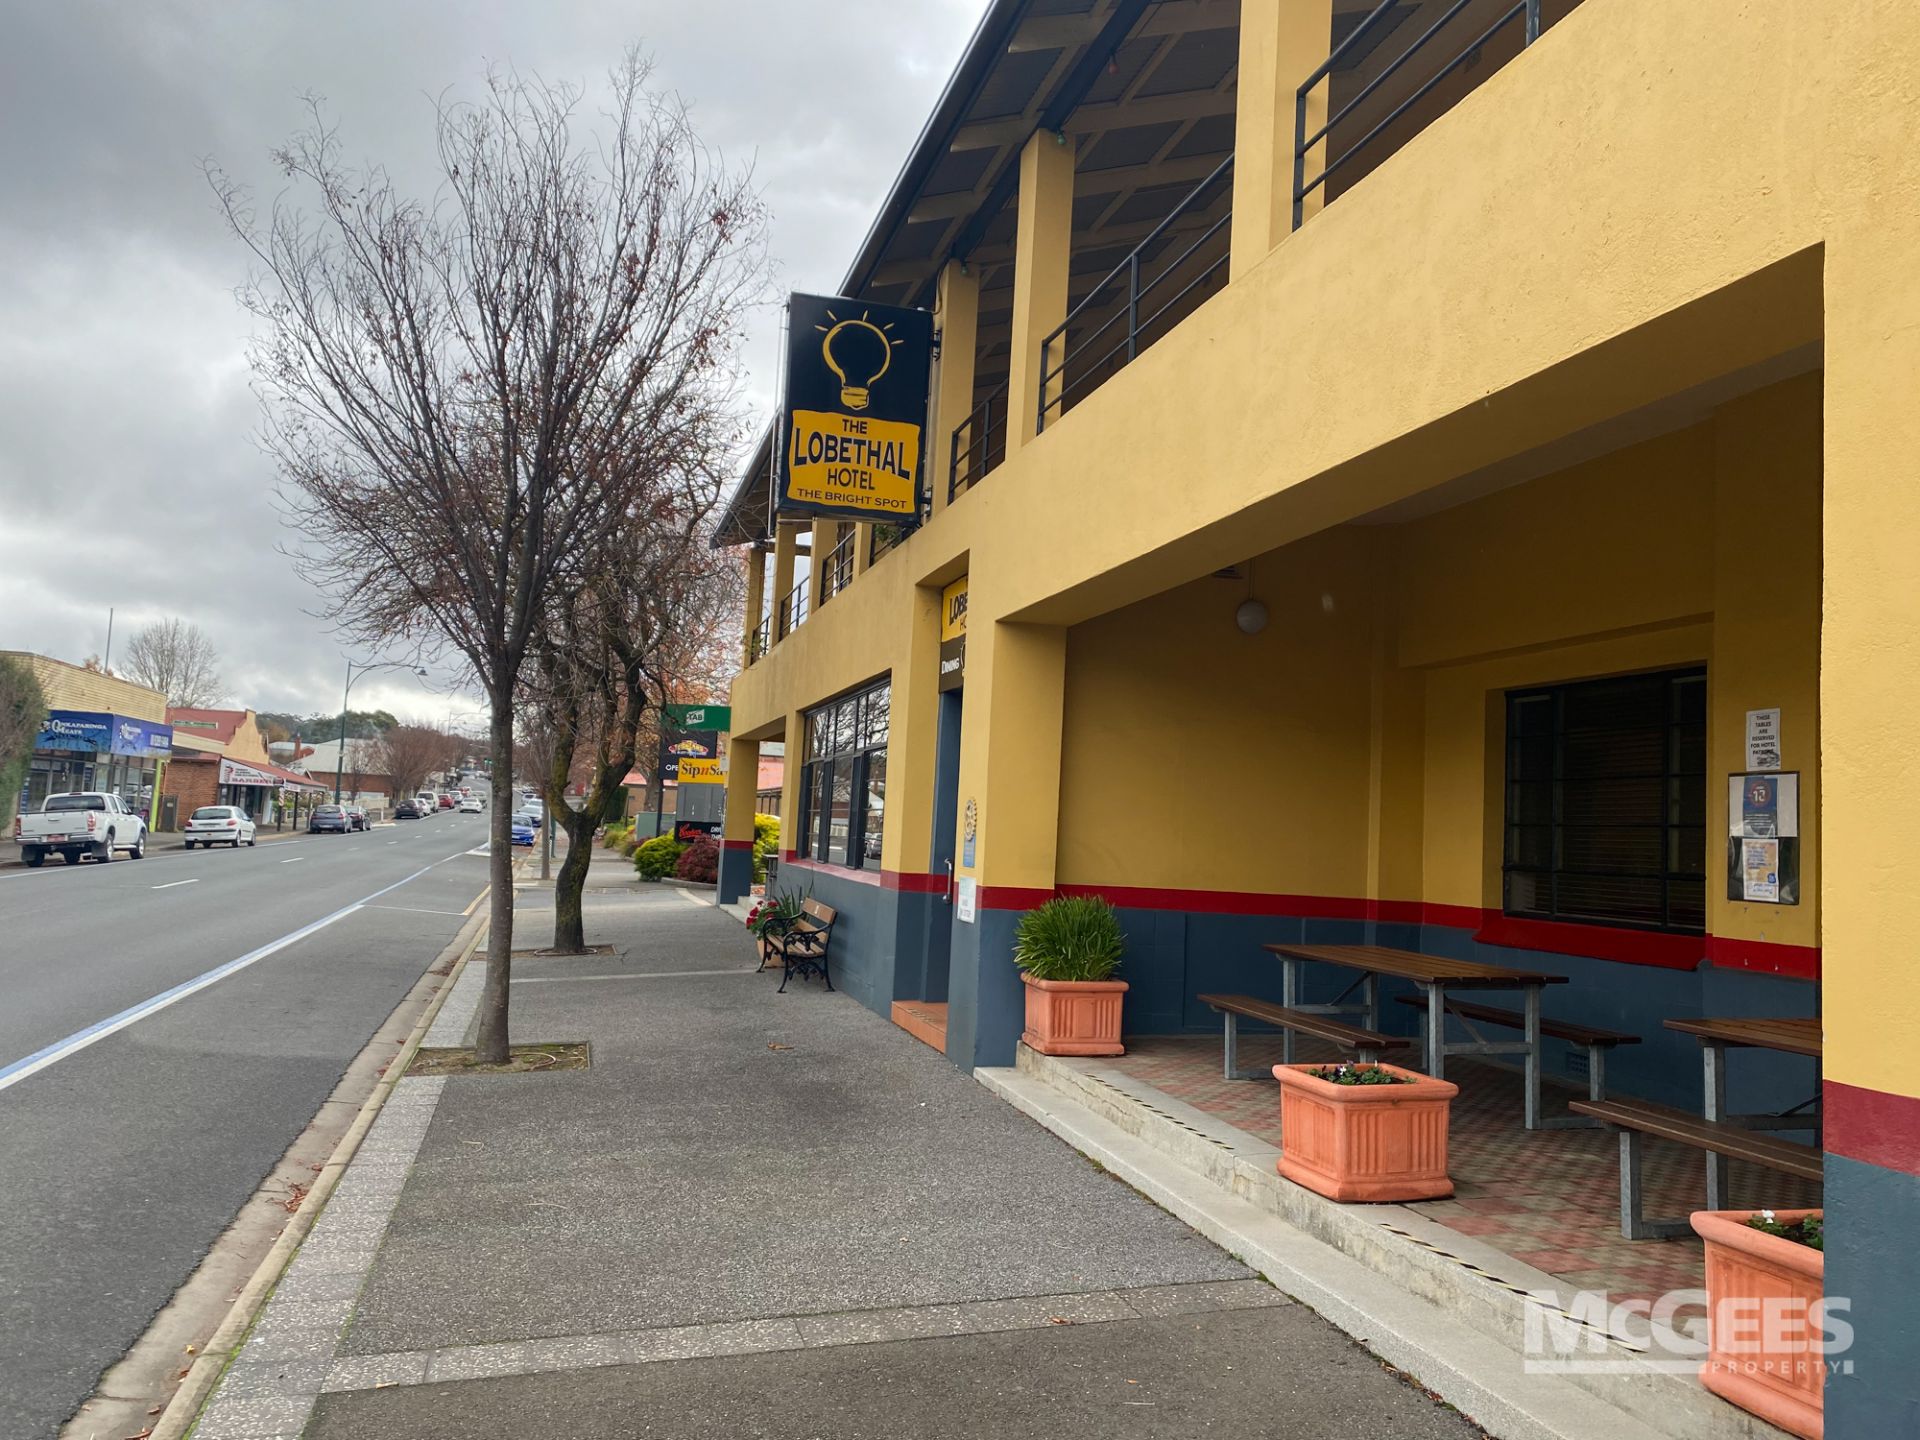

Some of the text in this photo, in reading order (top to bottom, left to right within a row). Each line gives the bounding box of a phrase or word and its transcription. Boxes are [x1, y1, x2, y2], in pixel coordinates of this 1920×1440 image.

[842, 419, 868, 434] THE
[794, 428, 910, 480] LOBETHAL
[827, 468, 875, 491] HOTEL
[797, 488, 907, 509] THE BRIGHT SPOT
[949, 591, 968, 626] LOBE
[688, 713, 702, 721] TAB
